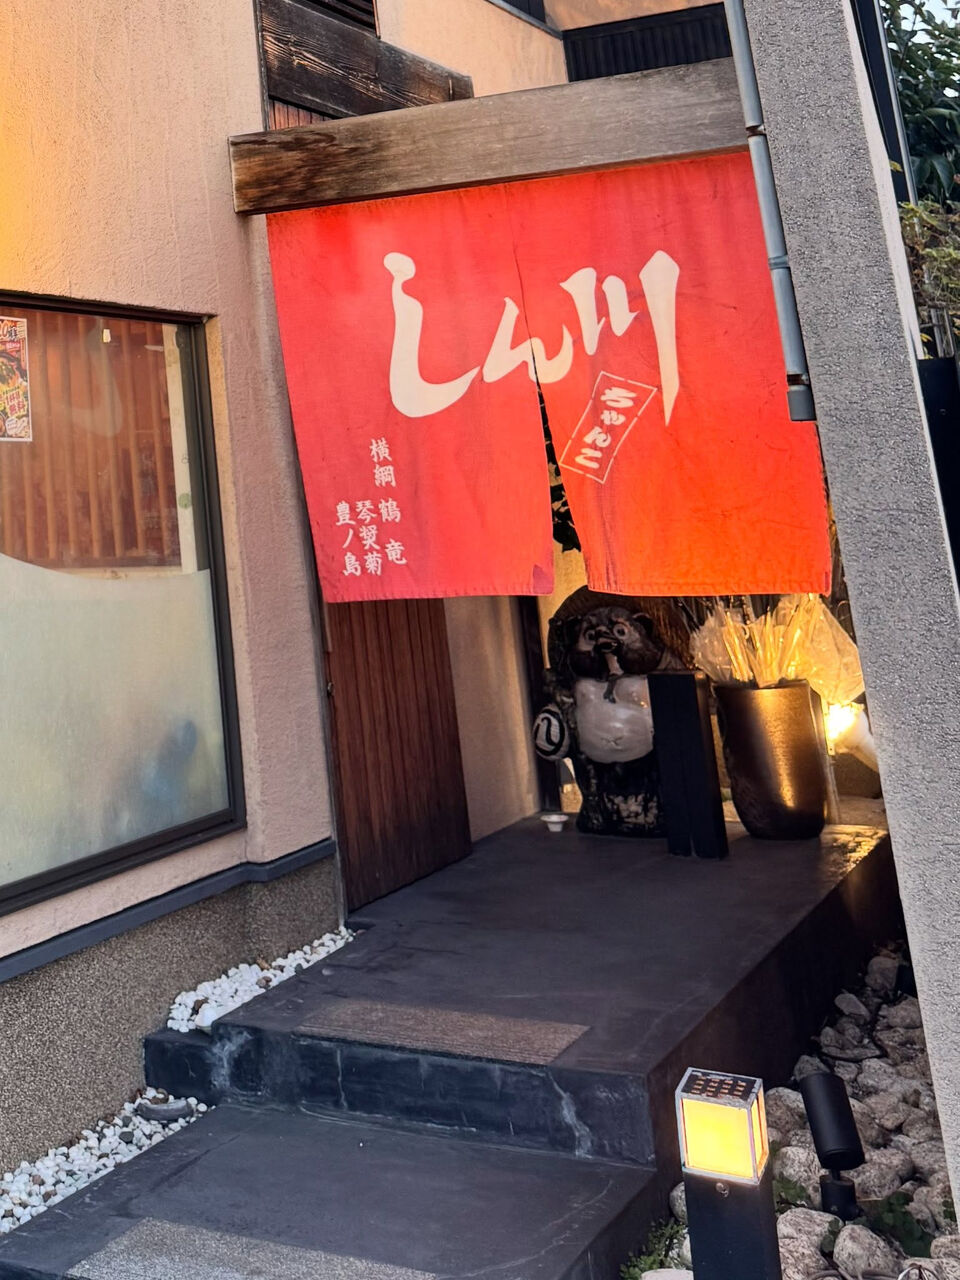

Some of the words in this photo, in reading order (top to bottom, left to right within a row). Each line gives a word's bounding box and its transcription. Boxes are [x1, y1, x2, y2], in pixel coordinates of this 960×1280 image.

[383, 249, 681, 426] しん川
[369, 437, 397, 488] 横綱
[575, 386, 637, 469] ちゃんこ
